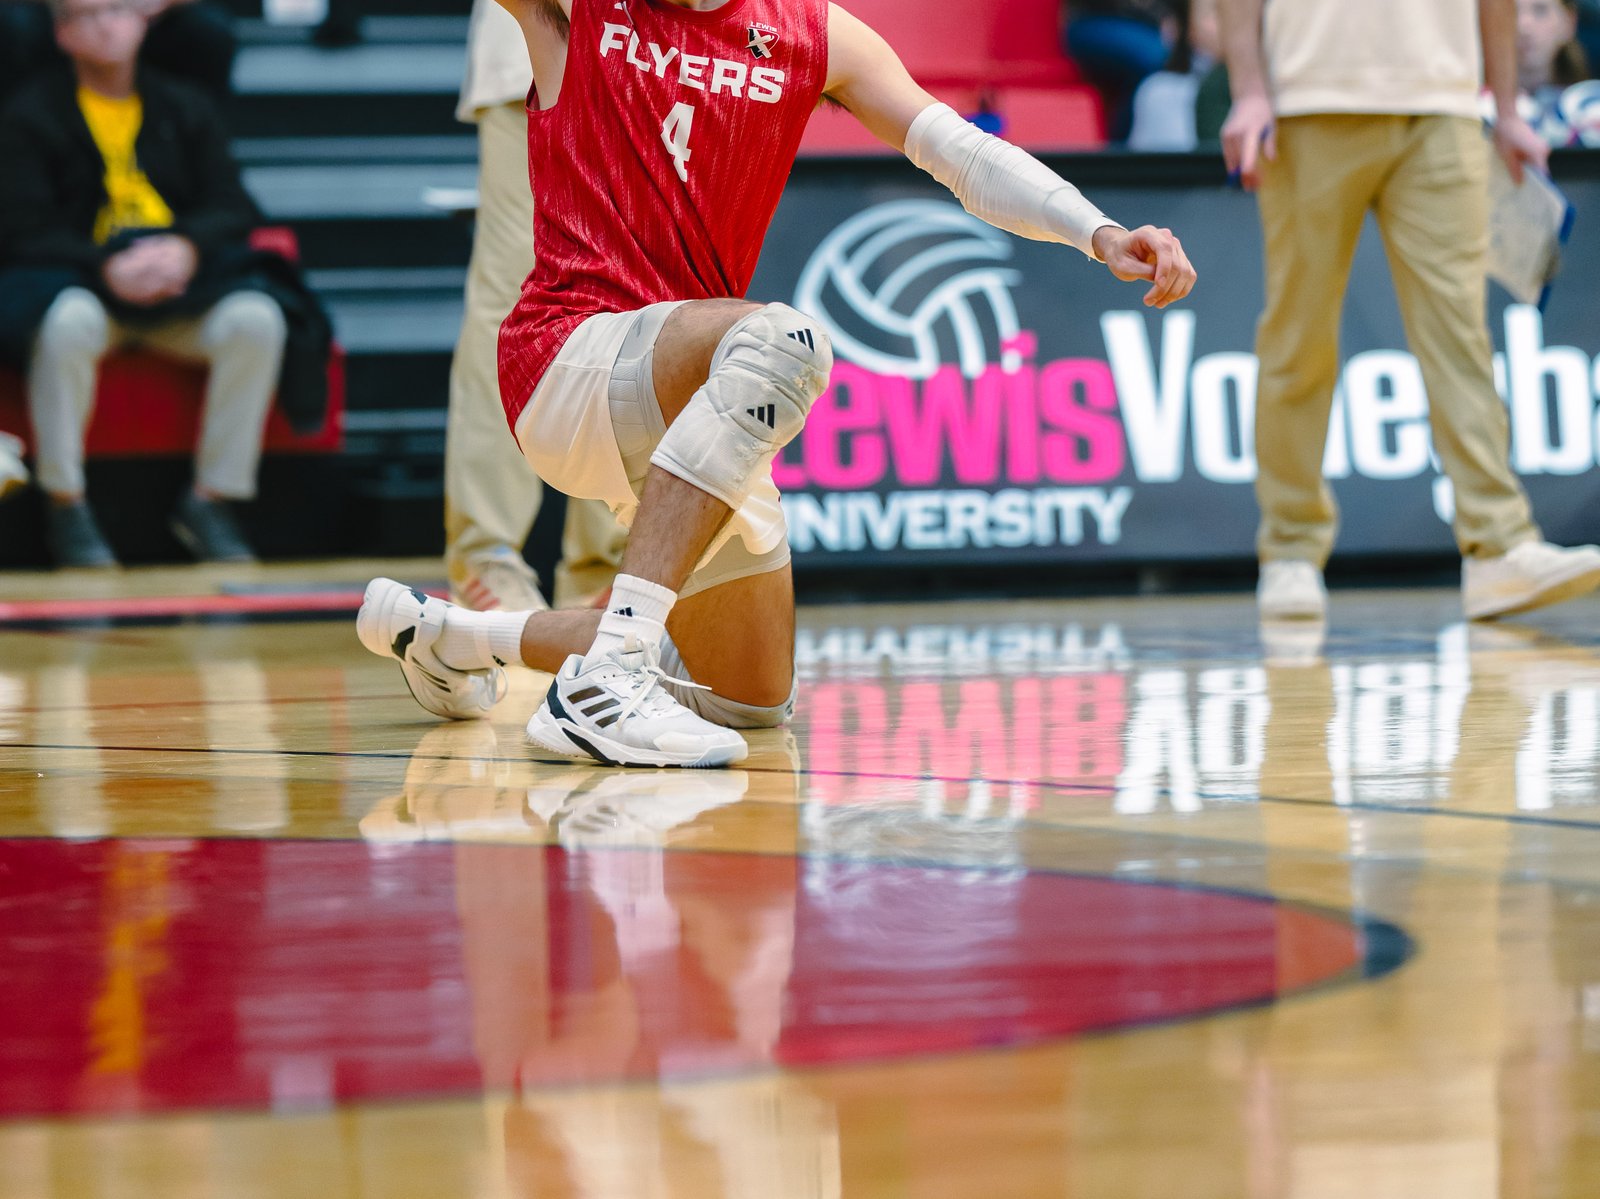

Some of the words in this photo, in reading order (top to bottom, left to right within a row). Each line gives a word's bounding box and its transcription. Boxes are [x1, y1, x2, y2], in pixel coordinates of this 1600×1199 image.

[600, 21, 785, 104] FLYERS
[750, 21, 778, 32] LEWIS
[660, 101, 695, 183] 4
[771, 330, 1125, 489] ewis
